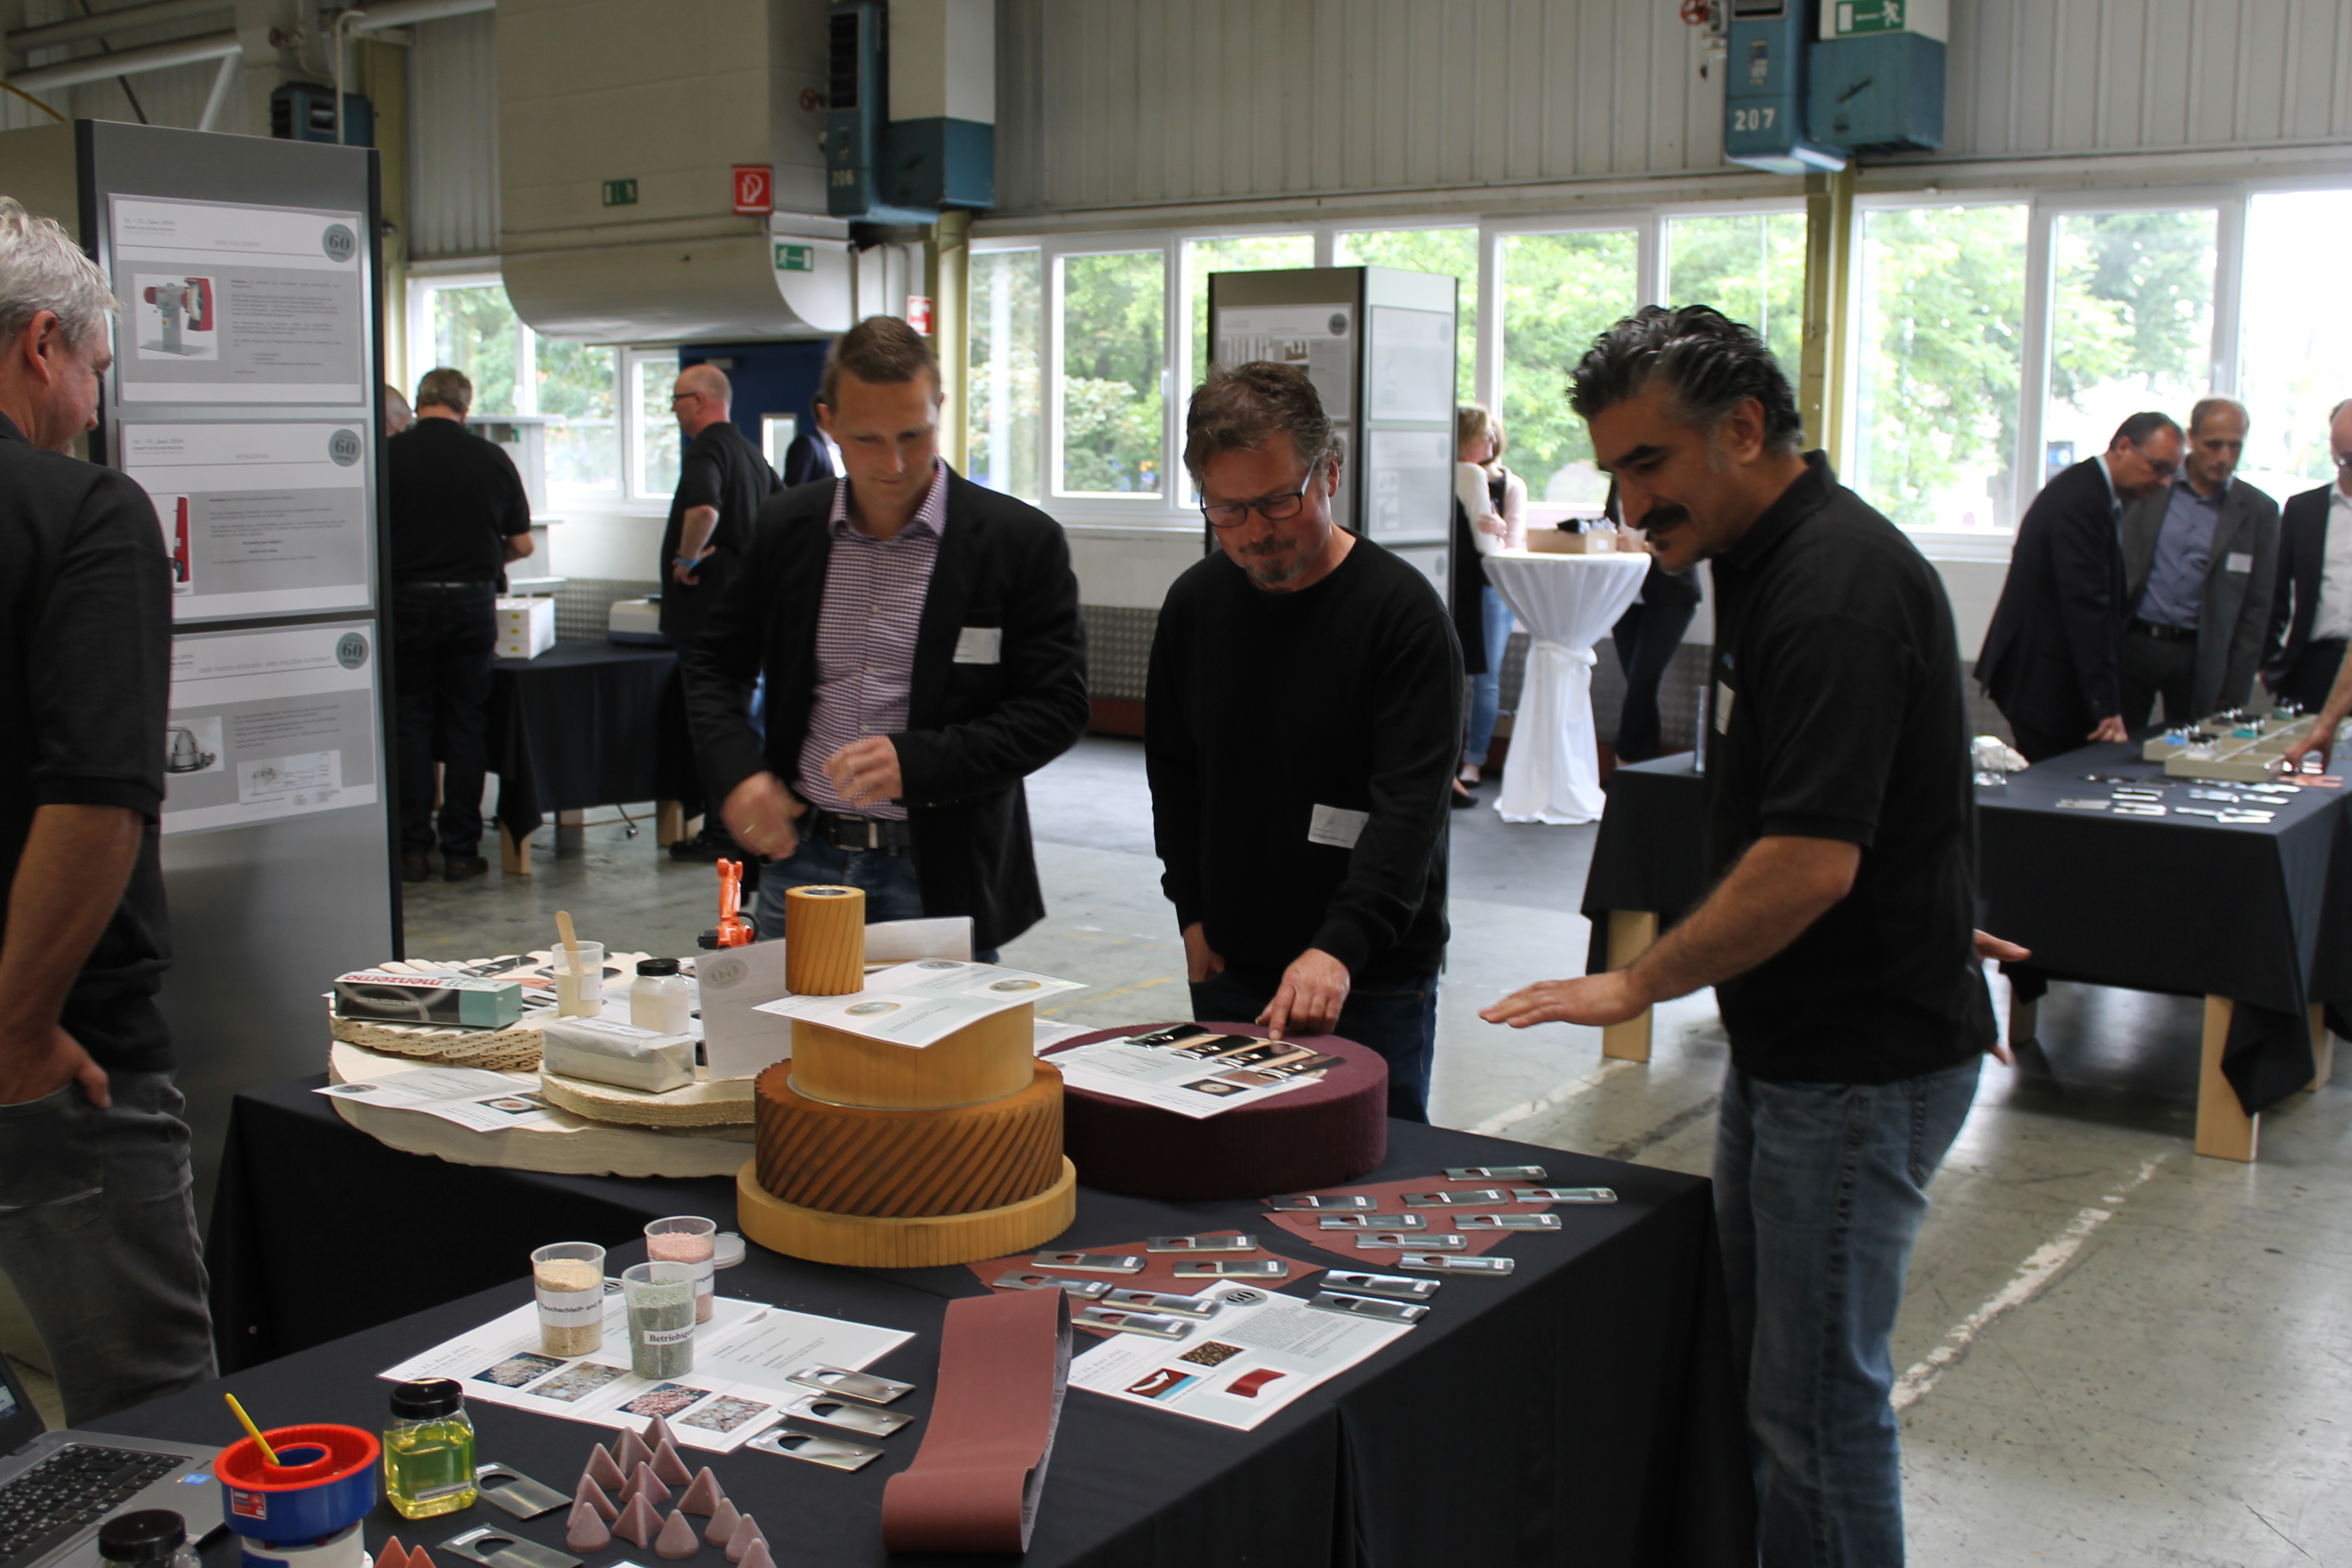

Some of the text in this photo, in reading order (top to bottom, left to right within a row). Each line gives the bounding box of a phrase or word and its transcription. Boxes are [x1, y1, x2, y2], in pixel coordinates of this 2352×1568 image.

[1735, 108, 1775, 131] 207
[328, 234, 350, 252] 60
[335, 439, 356, 455] 60
[342, 643, 363, 657] 60
[343, 975, 444, 986] menzerna
[1226, 1291, 1256, 1303] 60
[540, 1302, 584, 1314] Tauchschleif-
